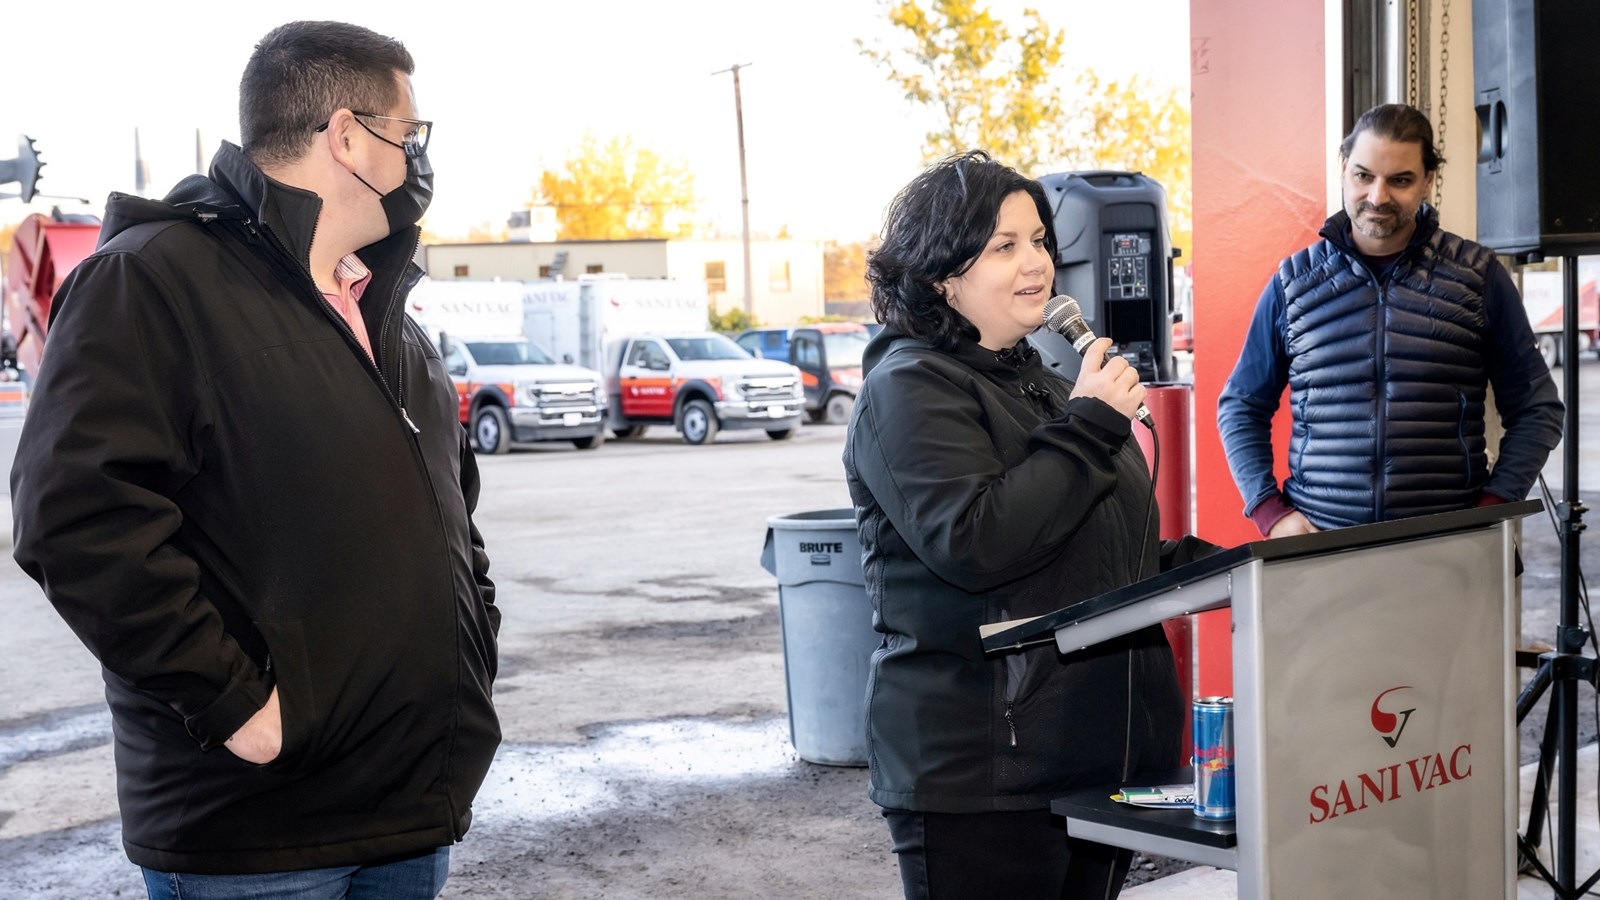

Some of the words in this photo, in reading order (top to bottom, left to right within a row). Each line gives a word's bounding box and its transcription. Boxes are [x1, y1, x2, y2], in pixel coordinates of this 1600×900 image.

[441, 303, 481, 313] SANI
[485, 302, 512, 313] VAC
[799, 542, 843, 553] BRUTE
[1310, 764, 1401, 824] SANI
[1406, 744, 1472, 792] VAC
